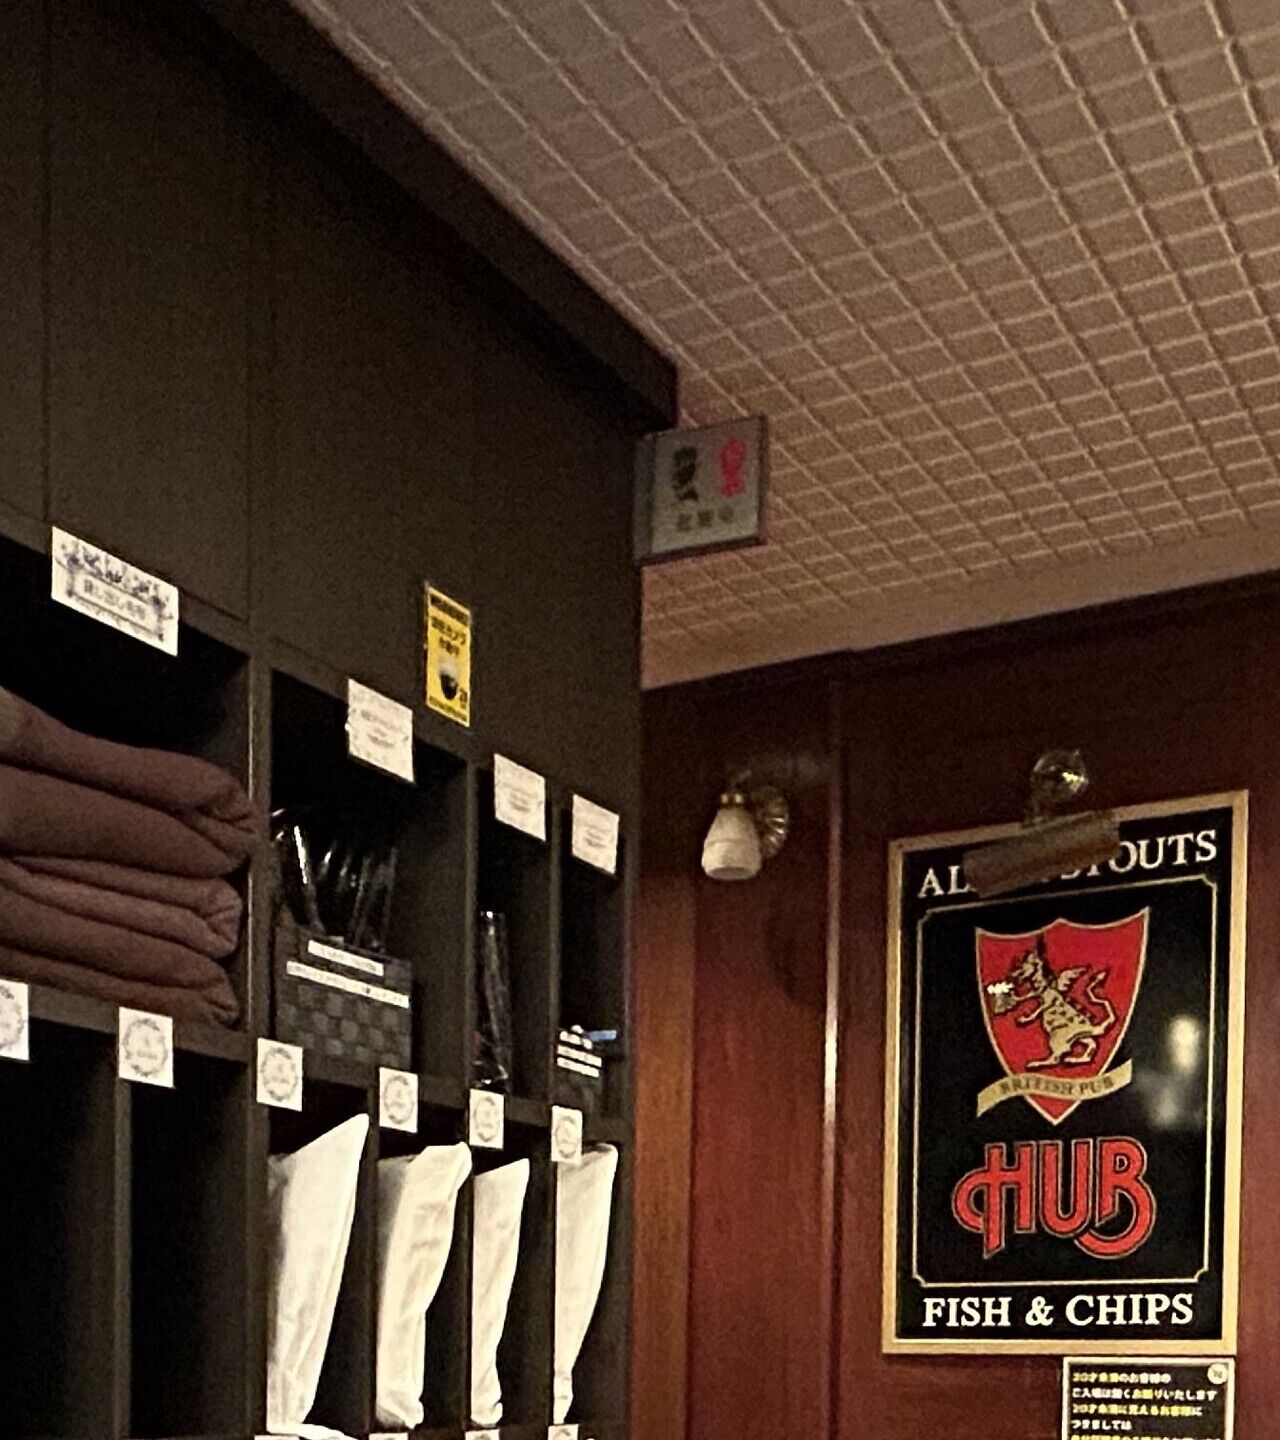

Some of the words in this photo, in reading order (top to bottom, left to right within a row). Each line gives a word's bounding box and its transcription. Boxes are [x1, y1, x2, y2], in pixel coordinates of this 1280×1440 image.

[1079, 1076, 1113, 1095] PUB
[951, 1136, 1157, 1260] HUB
[922, 1297, 1012, 1327] FISH
[1025, 1295, 1054, 1326] &
[1065, 1293, 1193, 1326] CHIPS
